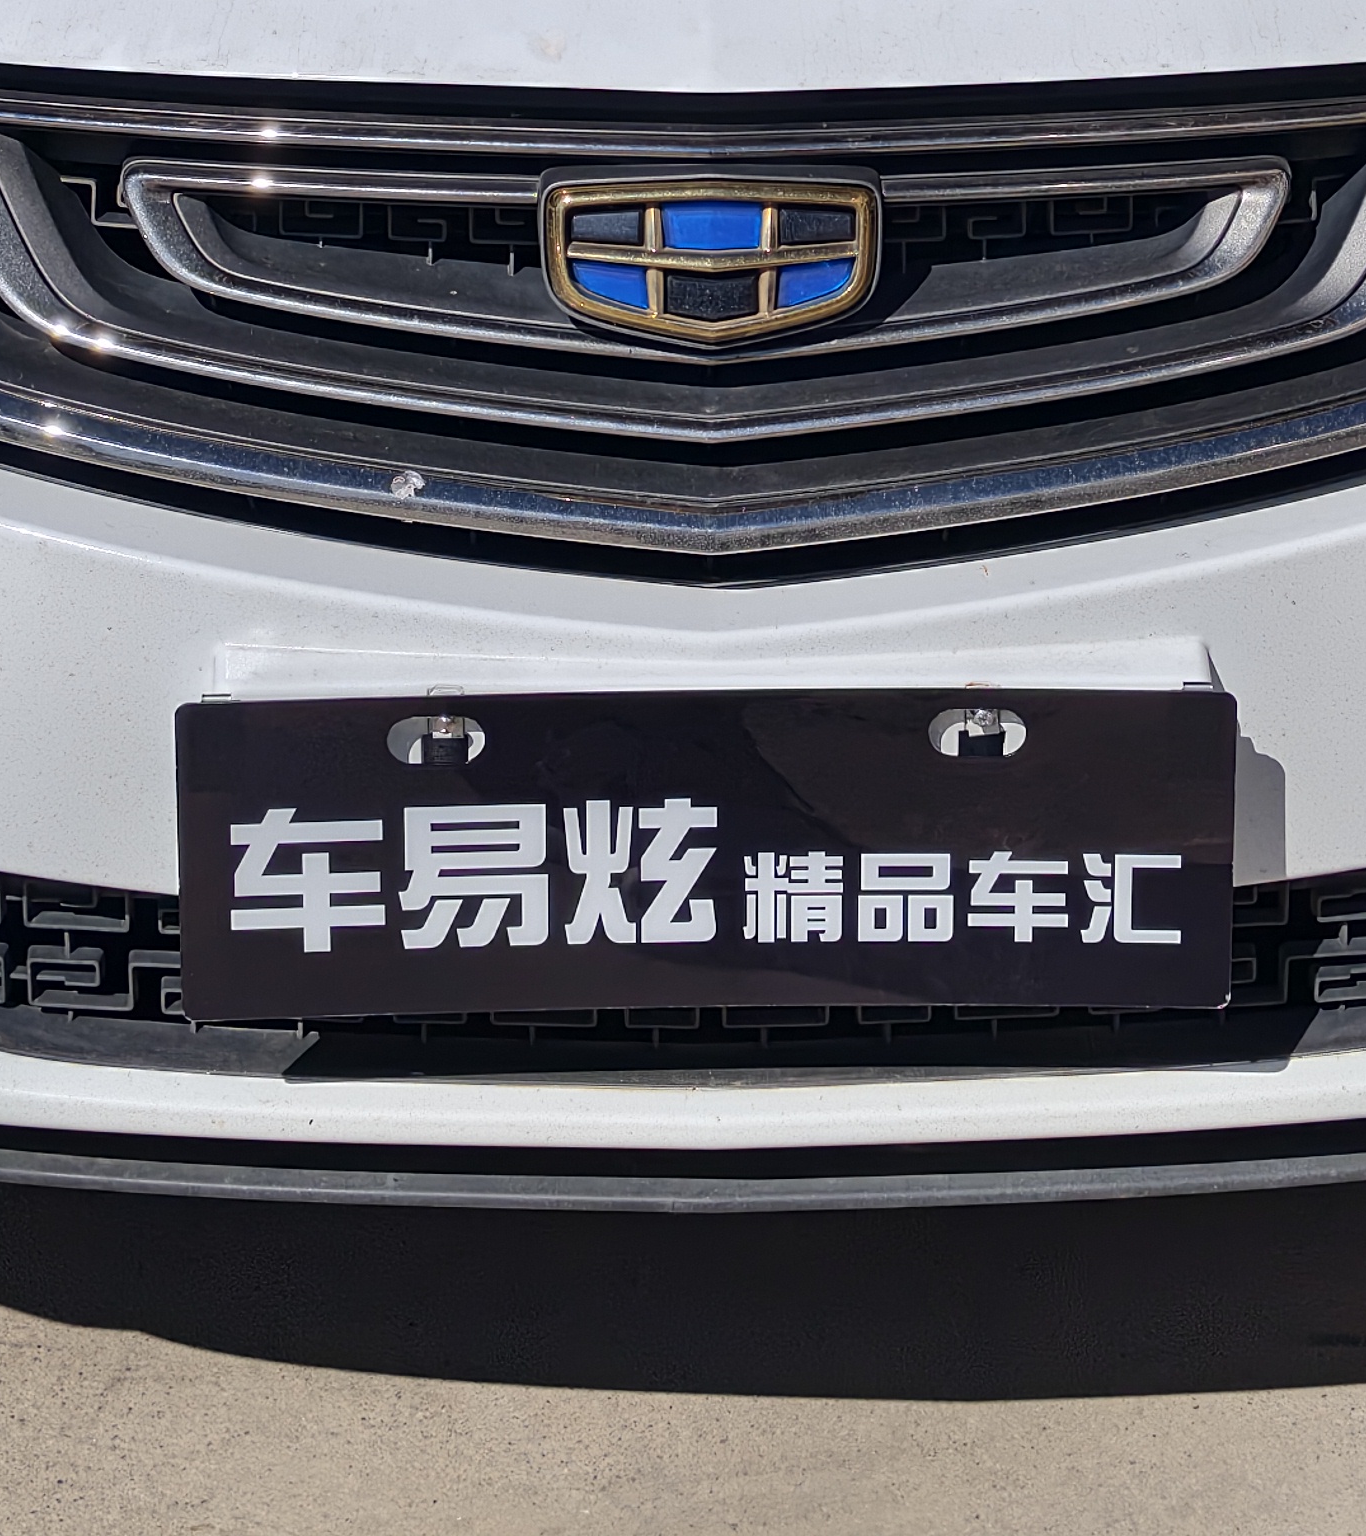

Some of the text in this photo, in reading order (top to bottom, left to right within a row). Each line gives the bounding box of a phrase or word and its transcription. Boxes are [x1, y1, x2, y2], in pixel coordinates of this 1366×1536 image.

[229, 797, 1182, 954] 车易炫 精品车汇
